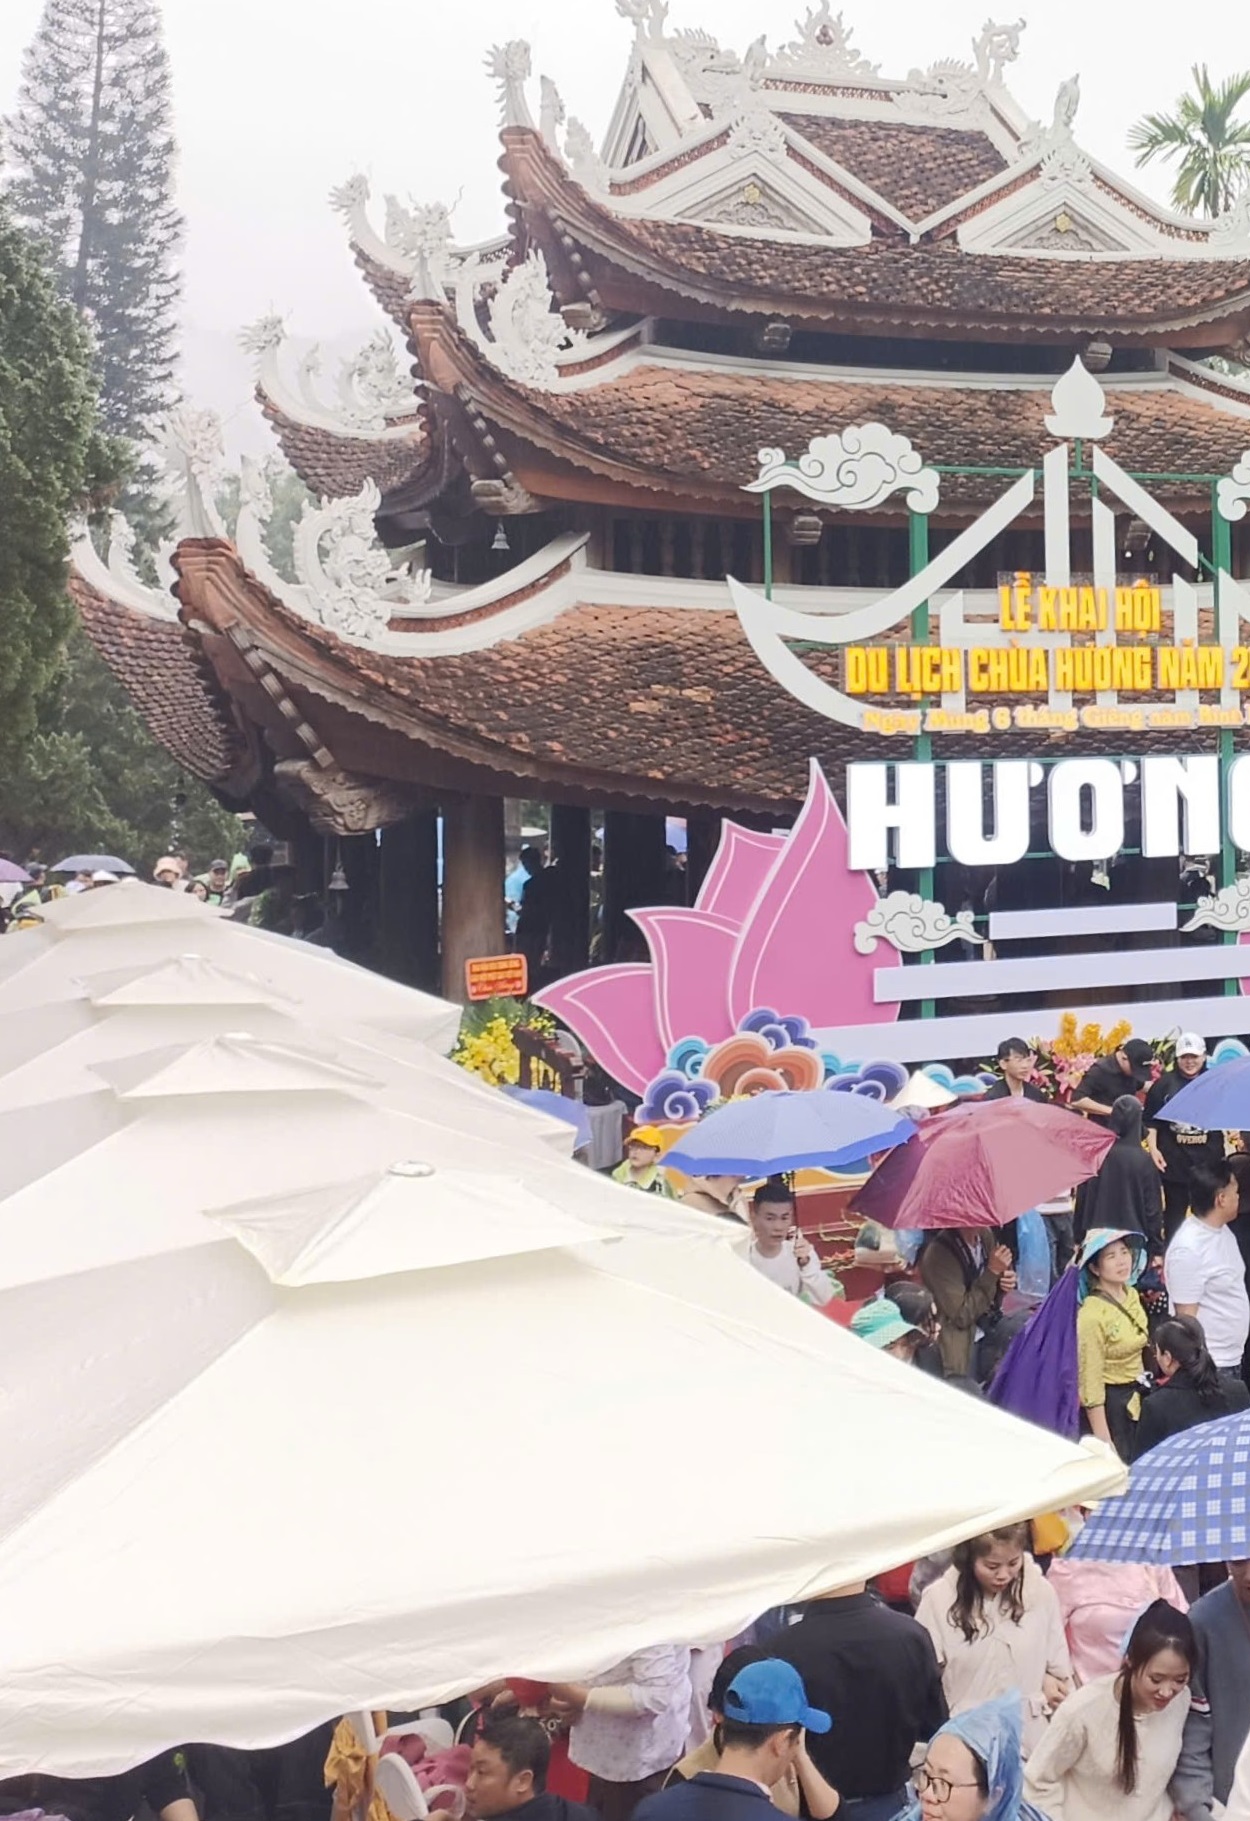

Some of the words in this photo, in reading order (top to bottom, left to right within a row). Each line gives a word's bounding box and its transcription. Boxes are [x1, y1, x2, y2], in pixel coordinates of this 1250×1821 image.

[998, 571, 1032, 632] LỄ
[1038, 586, 1107, 632] KHAI
[1114, 579, 1161, 638] HỘI
[846, 647, 888, 693] DU
[896, 647, 961, 700] LỊCH
[969, 639, 1048, 692] CHÙA
[1056, 642, 1151, 691] HƯƠNG
[1157, 638, 1223, 690] NĂM
[992, 707, 1012, 730] 6
